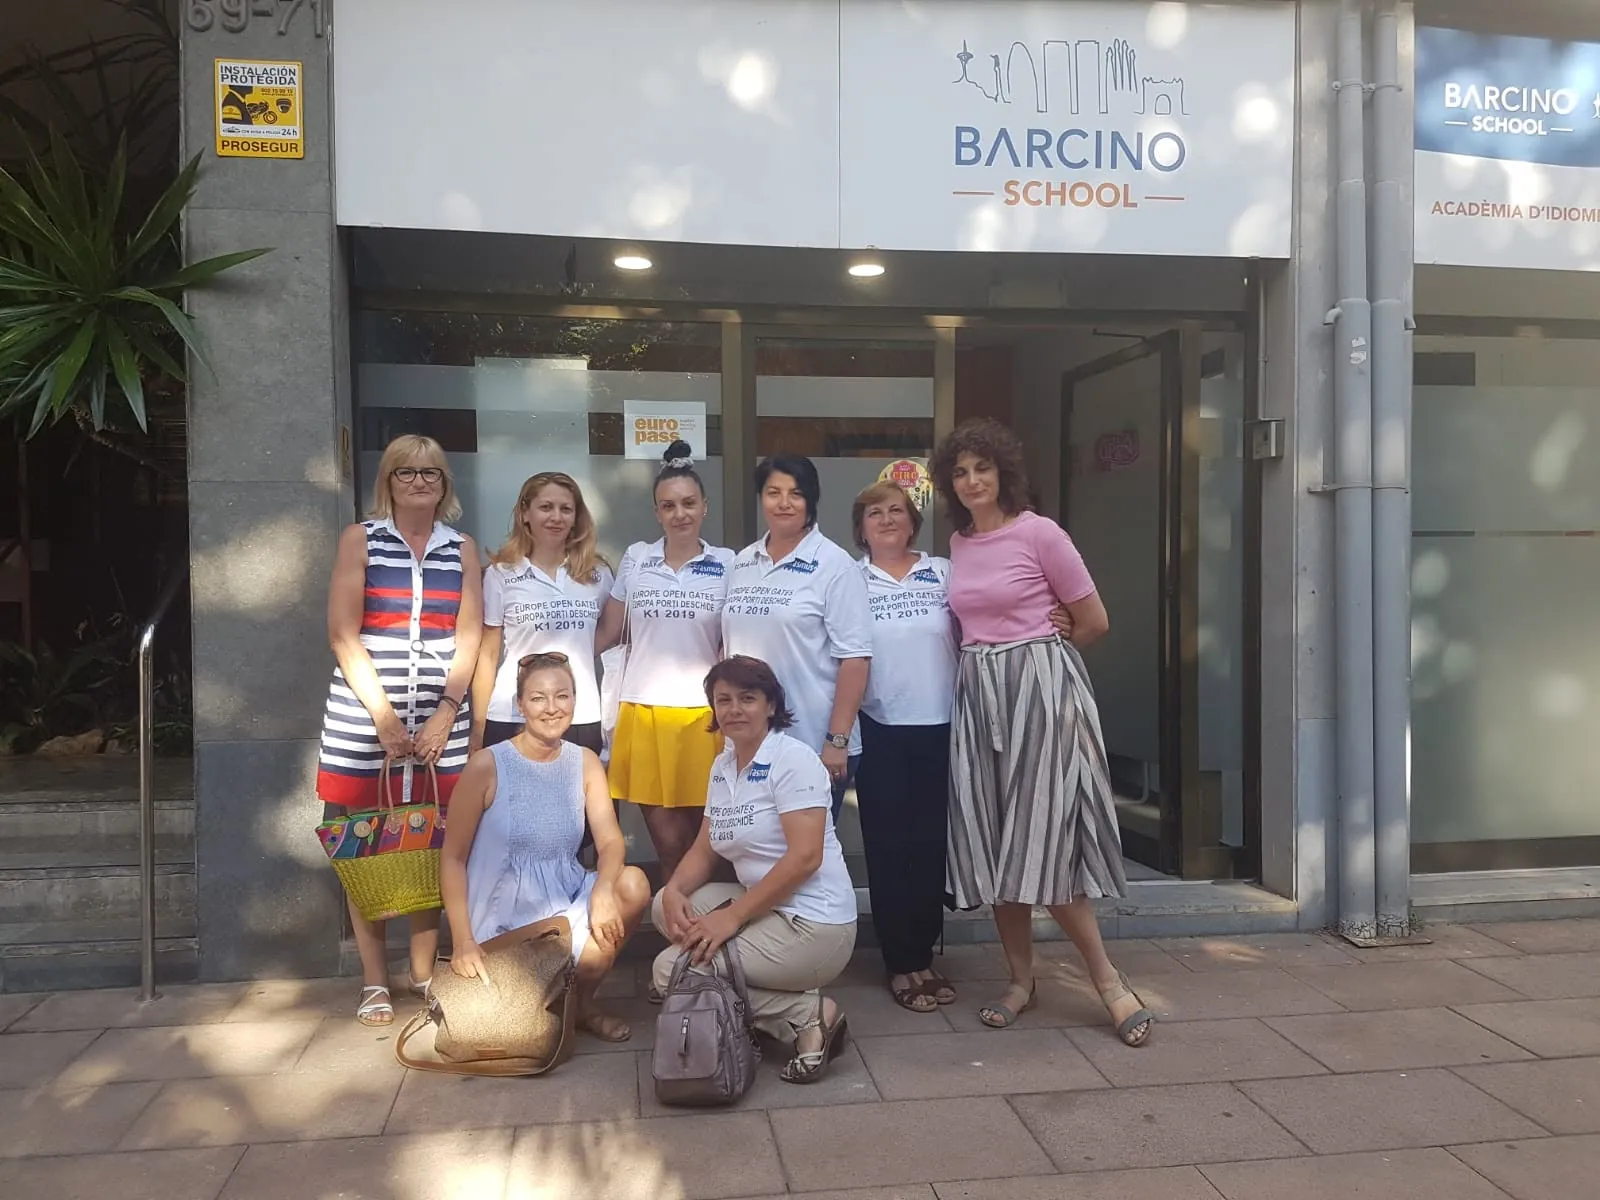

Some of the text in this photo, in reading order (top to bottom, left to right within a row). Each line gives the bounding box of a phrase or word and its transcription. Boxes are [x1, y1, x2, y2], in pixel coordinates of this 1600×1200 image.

[220, 65, 296, 77] INSTALACIÓN
[220, 74, 297, 86] PROTEGIDA
[1444, 82, 1578, 116] BARCINO
[1471, 115, 1548, 136] SCHOOL
[221, 140, 299, 153] PROSEGUR
[954, 125, 1187, 173] BARCINO
[1003, 180, 1138, 209] SCHOOL
[1431, 199, 1524, 219] ACADÈMIA
[634, 418, 679, 431] euro
[635, 431, 680, 446] pass
[632, 590, 715, 602] EUROPE OPEN GATES
[751, 586, 771, 595] OPEN
[891, 592, 914, 601] OPEN
[515, 601, 549, 614] EUROPE
[550, 600, 573, 609] OPEN
[728, 605, 770, 616] K1 2019
[516, 613, 546, 625] EUROPA
[643, 609, 696, 620] K1 2019
[875, 608, 929, 621] K1 2019
[534, 621, 585, 632] K1 2019
